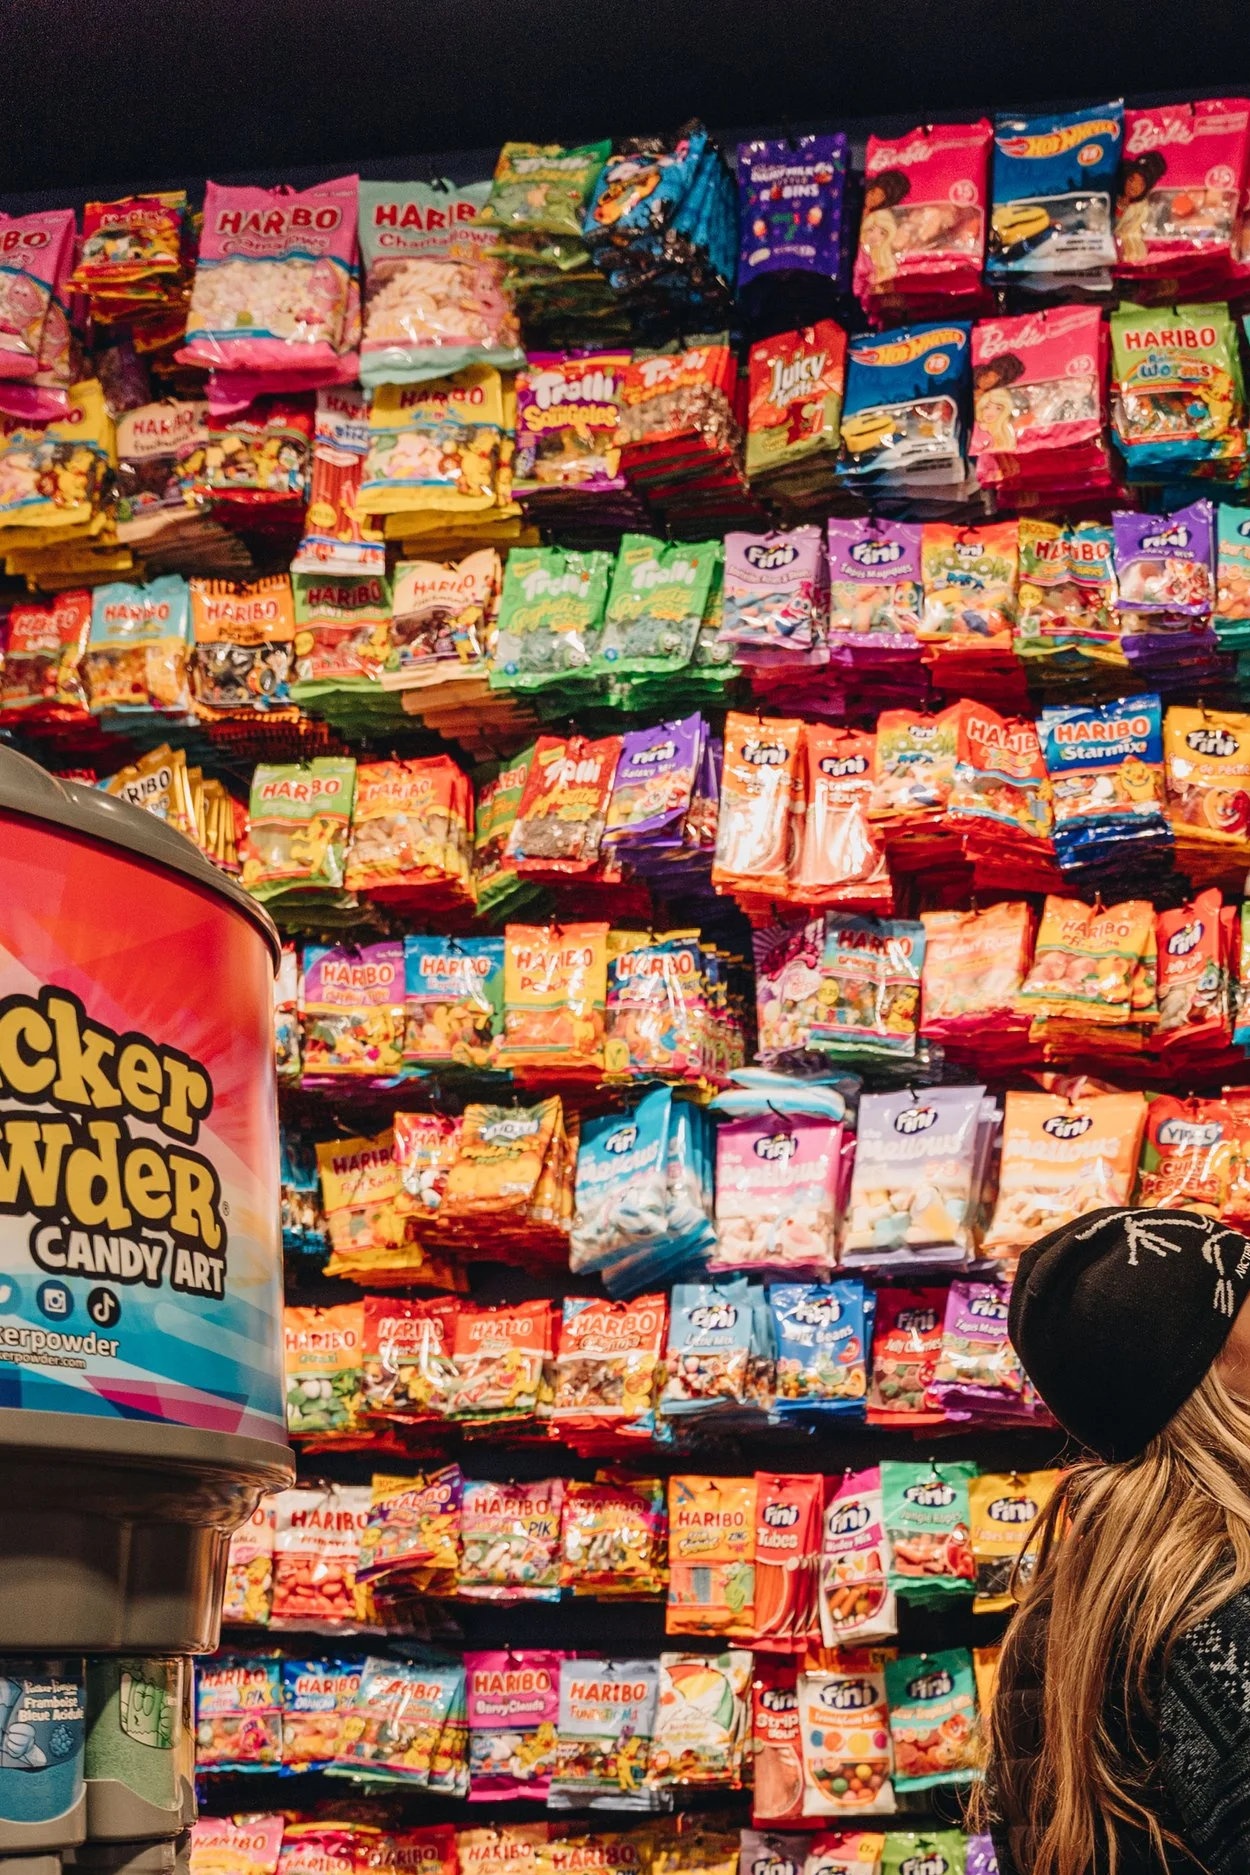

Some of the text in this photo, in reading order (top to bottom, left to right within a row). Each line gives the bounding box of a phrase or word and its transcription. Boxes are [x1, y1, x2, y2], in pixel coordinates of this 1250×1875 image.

[1026, 120, 1119, 157] HOT WHEELS
[1127, 117, 1195, 152] Barbie
[218, 207, 341, 236] HARIBO
[375, 201, 477, 232] HARIB
[979, 327, 1045, 357] Barbie
[1124, 326, 1216, 350] HARIBO
[769, 353, 827, 396] Juicy
[531, 372, 615, 408] Trolli
[523, 405, 619, 431] Squiggles
[747, 545, 798, 568] Fini
[852, 543, 901, 565] Fini
[523, 569, 590, 599] Trolli
[631, 560, 698, 587] Trolli
[308, 580, 381, 604] HARIBO
[207, 600, 279, 621] HARIBO
[1054, 717, 1150, 743] HARIBO
[1063, 740, 1147, 761] Starmix
[1189, 730, 1237, 756] Fini
[821, 757, 867, 777] Fini
[262, 778, 341, 801] HARIBO
[1169, 925, 1204, 954] Fini
[321, 963, 394, 984] HARIBO
[0, 997, 208, 1135] cker
[894, 1108, 937, 1133] Fini
[1043, 1117, 1091, 1138] Fini
[35, 1225, 225, 1294] CANDY ART
[474, 1498, 552, 1516] HARIBO
[907, 1486, 955, 1505] Fini
[291, 1509, 368, 1529] HARIBO
[679, 1511, 745, 1528] HARIBO
[763, 1507, 799, 1526] Fini
[829, 1505, 870, 1533] Fini
[989, 1499, 1037, 1520] Fini
[527, 1520, 552, 1538] PIK
[757, 1527, 797, 1549] Tubes
[474, 1672, 552, 1693] HARIBO
[24, 1695, 78, 1709] Framboise
[820, 1684, 877, 1707] Fini
